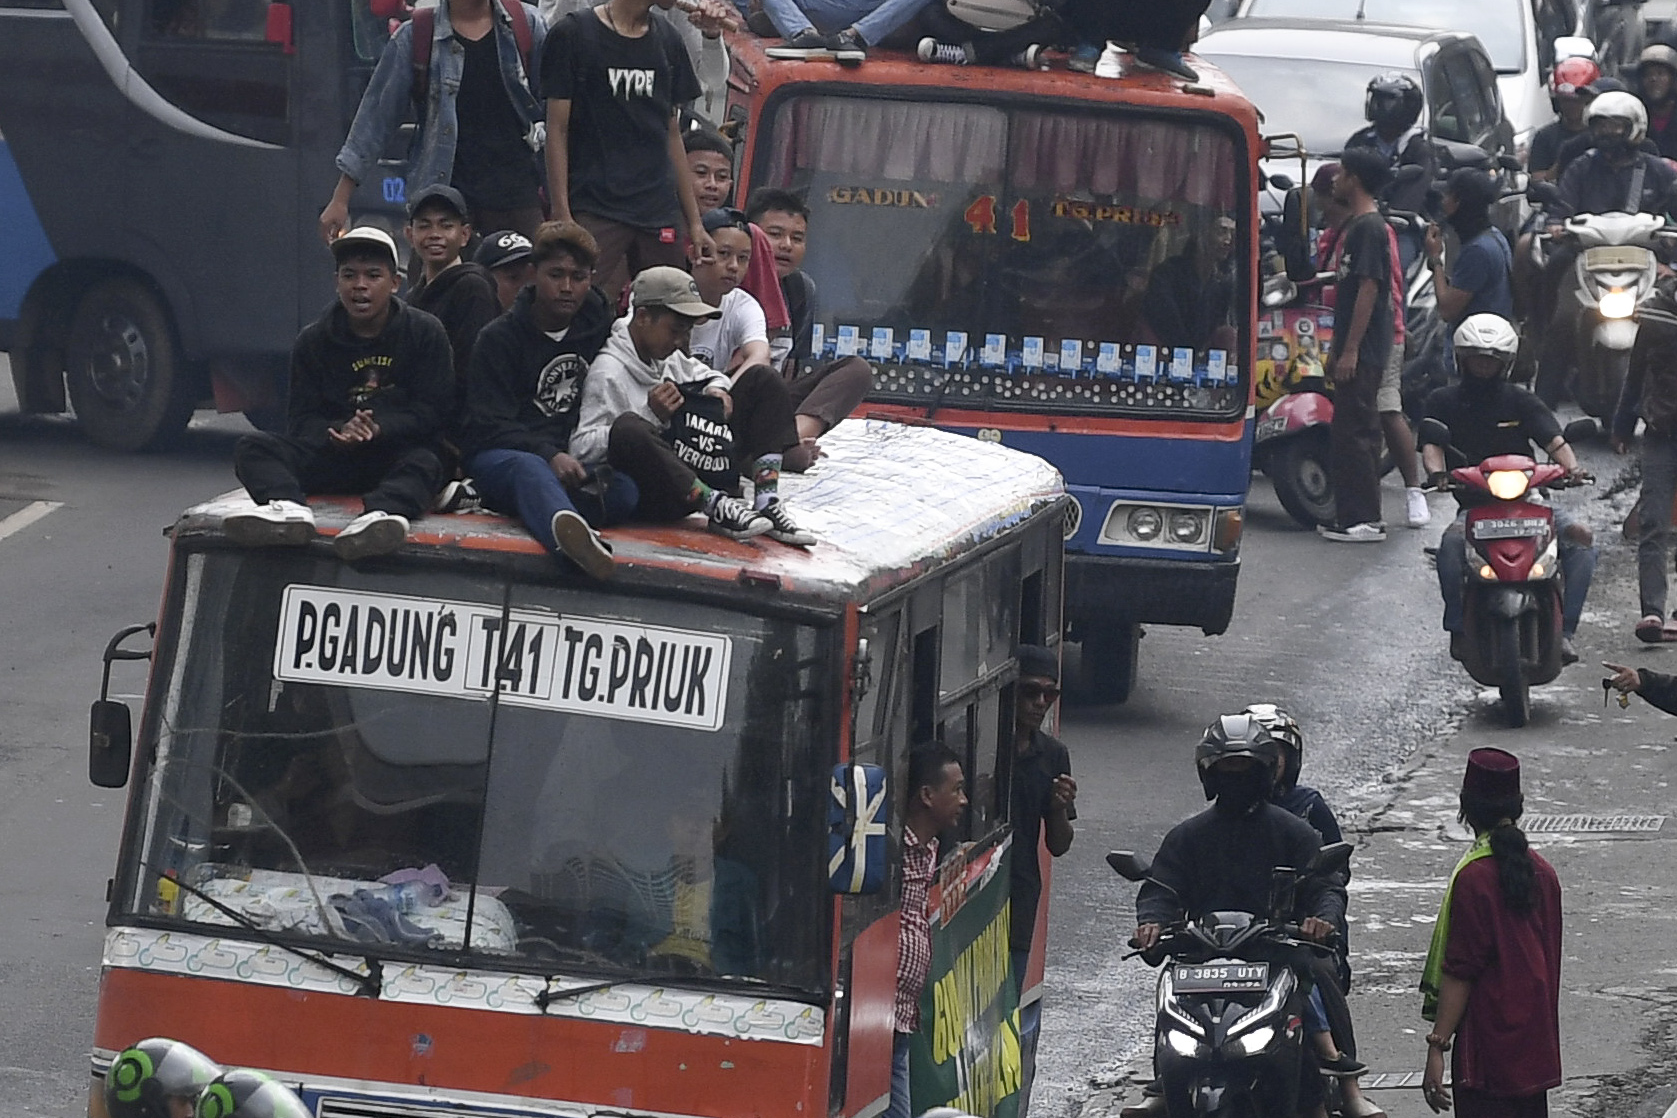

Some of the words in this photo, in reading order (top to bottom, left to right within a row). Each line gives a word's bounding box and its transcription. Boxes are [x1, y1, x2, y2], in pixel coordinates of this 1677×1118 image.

[293, 599, 457, 682] P.GADUNG
[563, 624, 714, 717] TG.PRIUK
[1180, 969, 1187, 980] B
[1194, 967, 1228, 979] 3835
[1237, 967, 1265, 978] UTY
